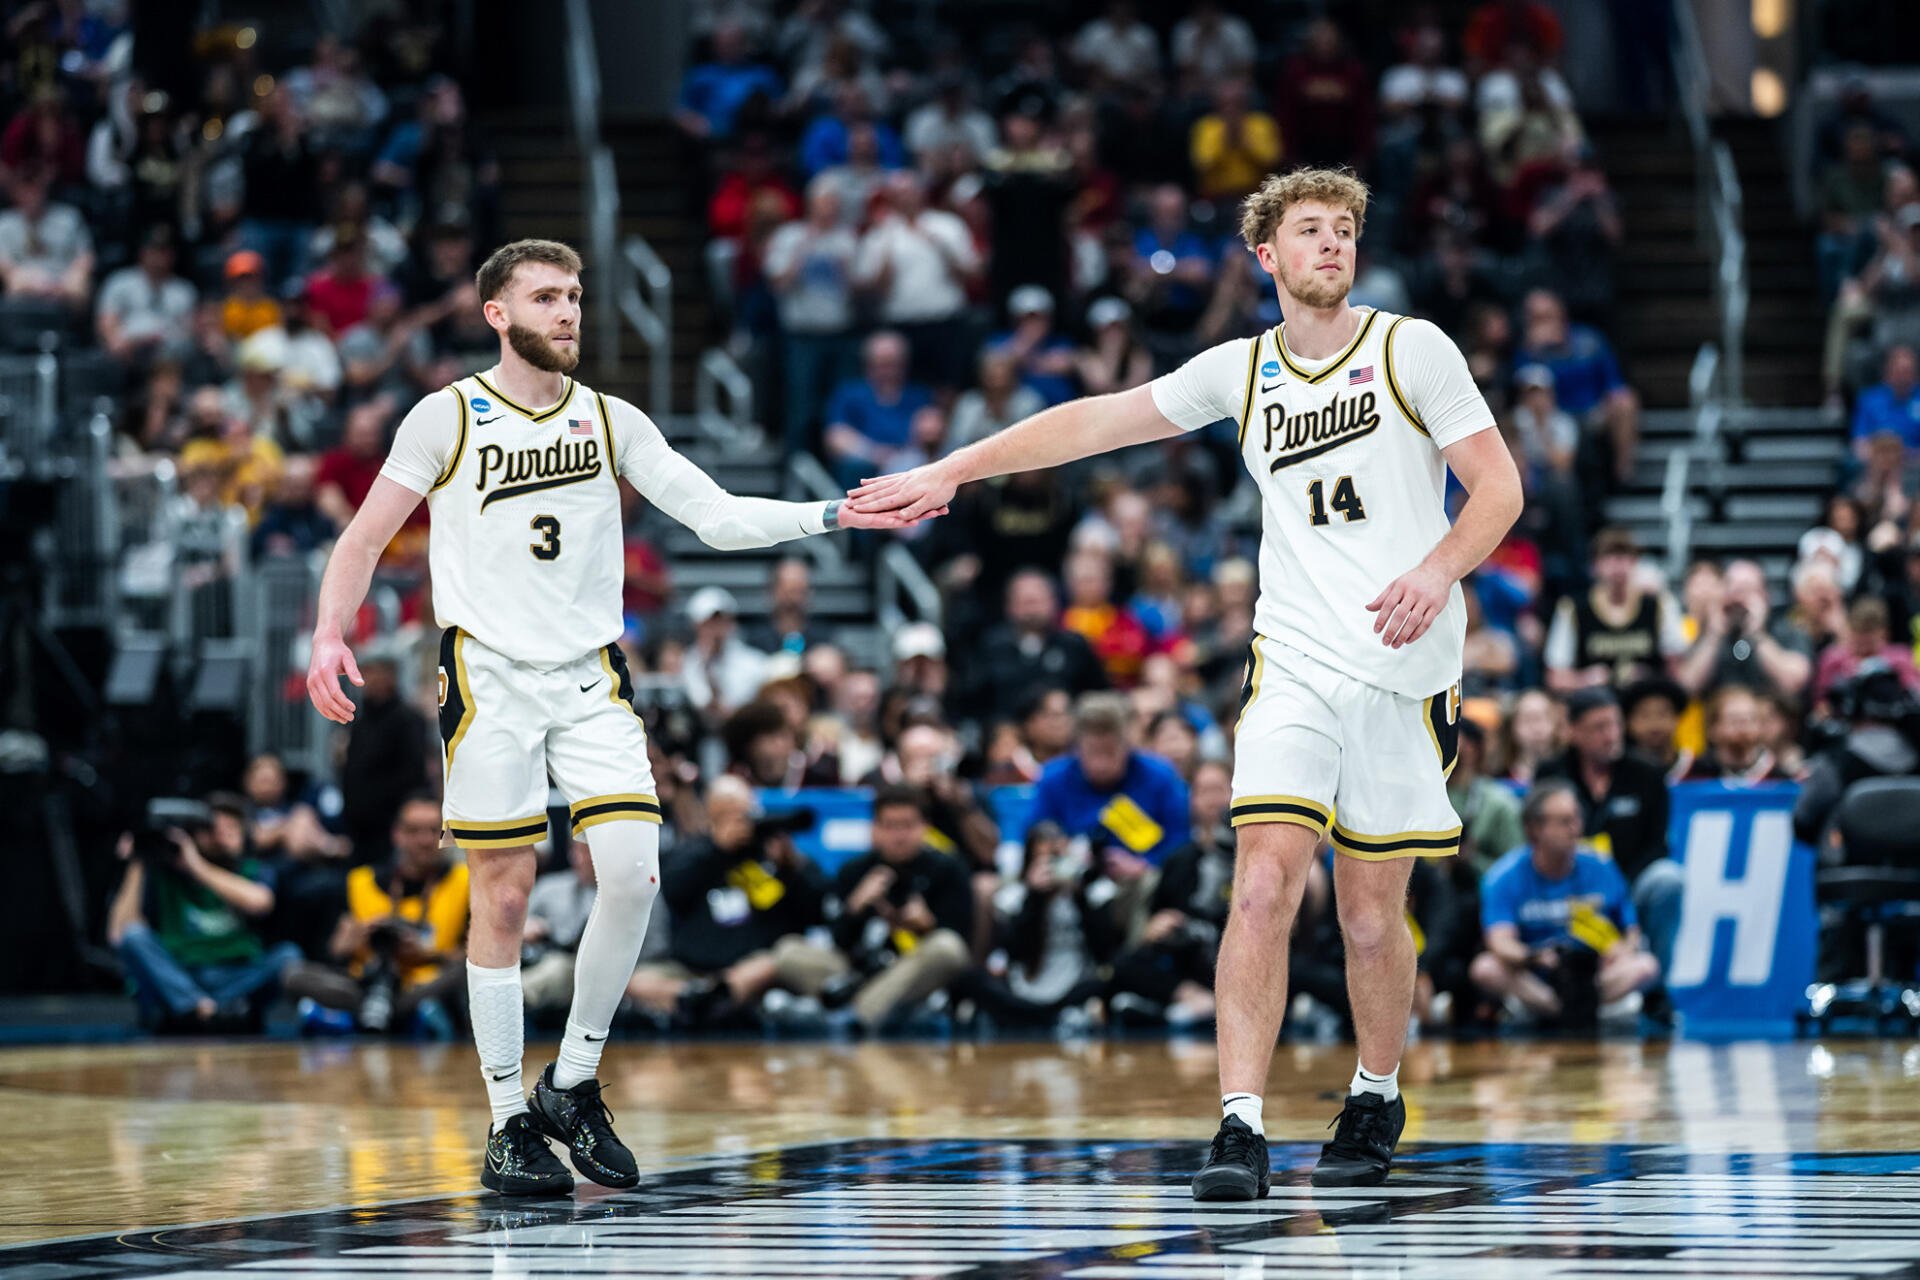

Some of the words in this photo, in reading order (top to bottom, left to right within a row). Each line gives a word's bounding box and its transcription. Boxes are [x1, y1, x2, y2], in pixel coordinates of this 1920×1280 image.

[1263, 391, 1381, 454] Purdue
[476, 434, 602, 492] Purdue
[1307, 475, 1367, 526] 14
[530, 514, 561, 561] 3
[1667, 809, 1793, 988] H
